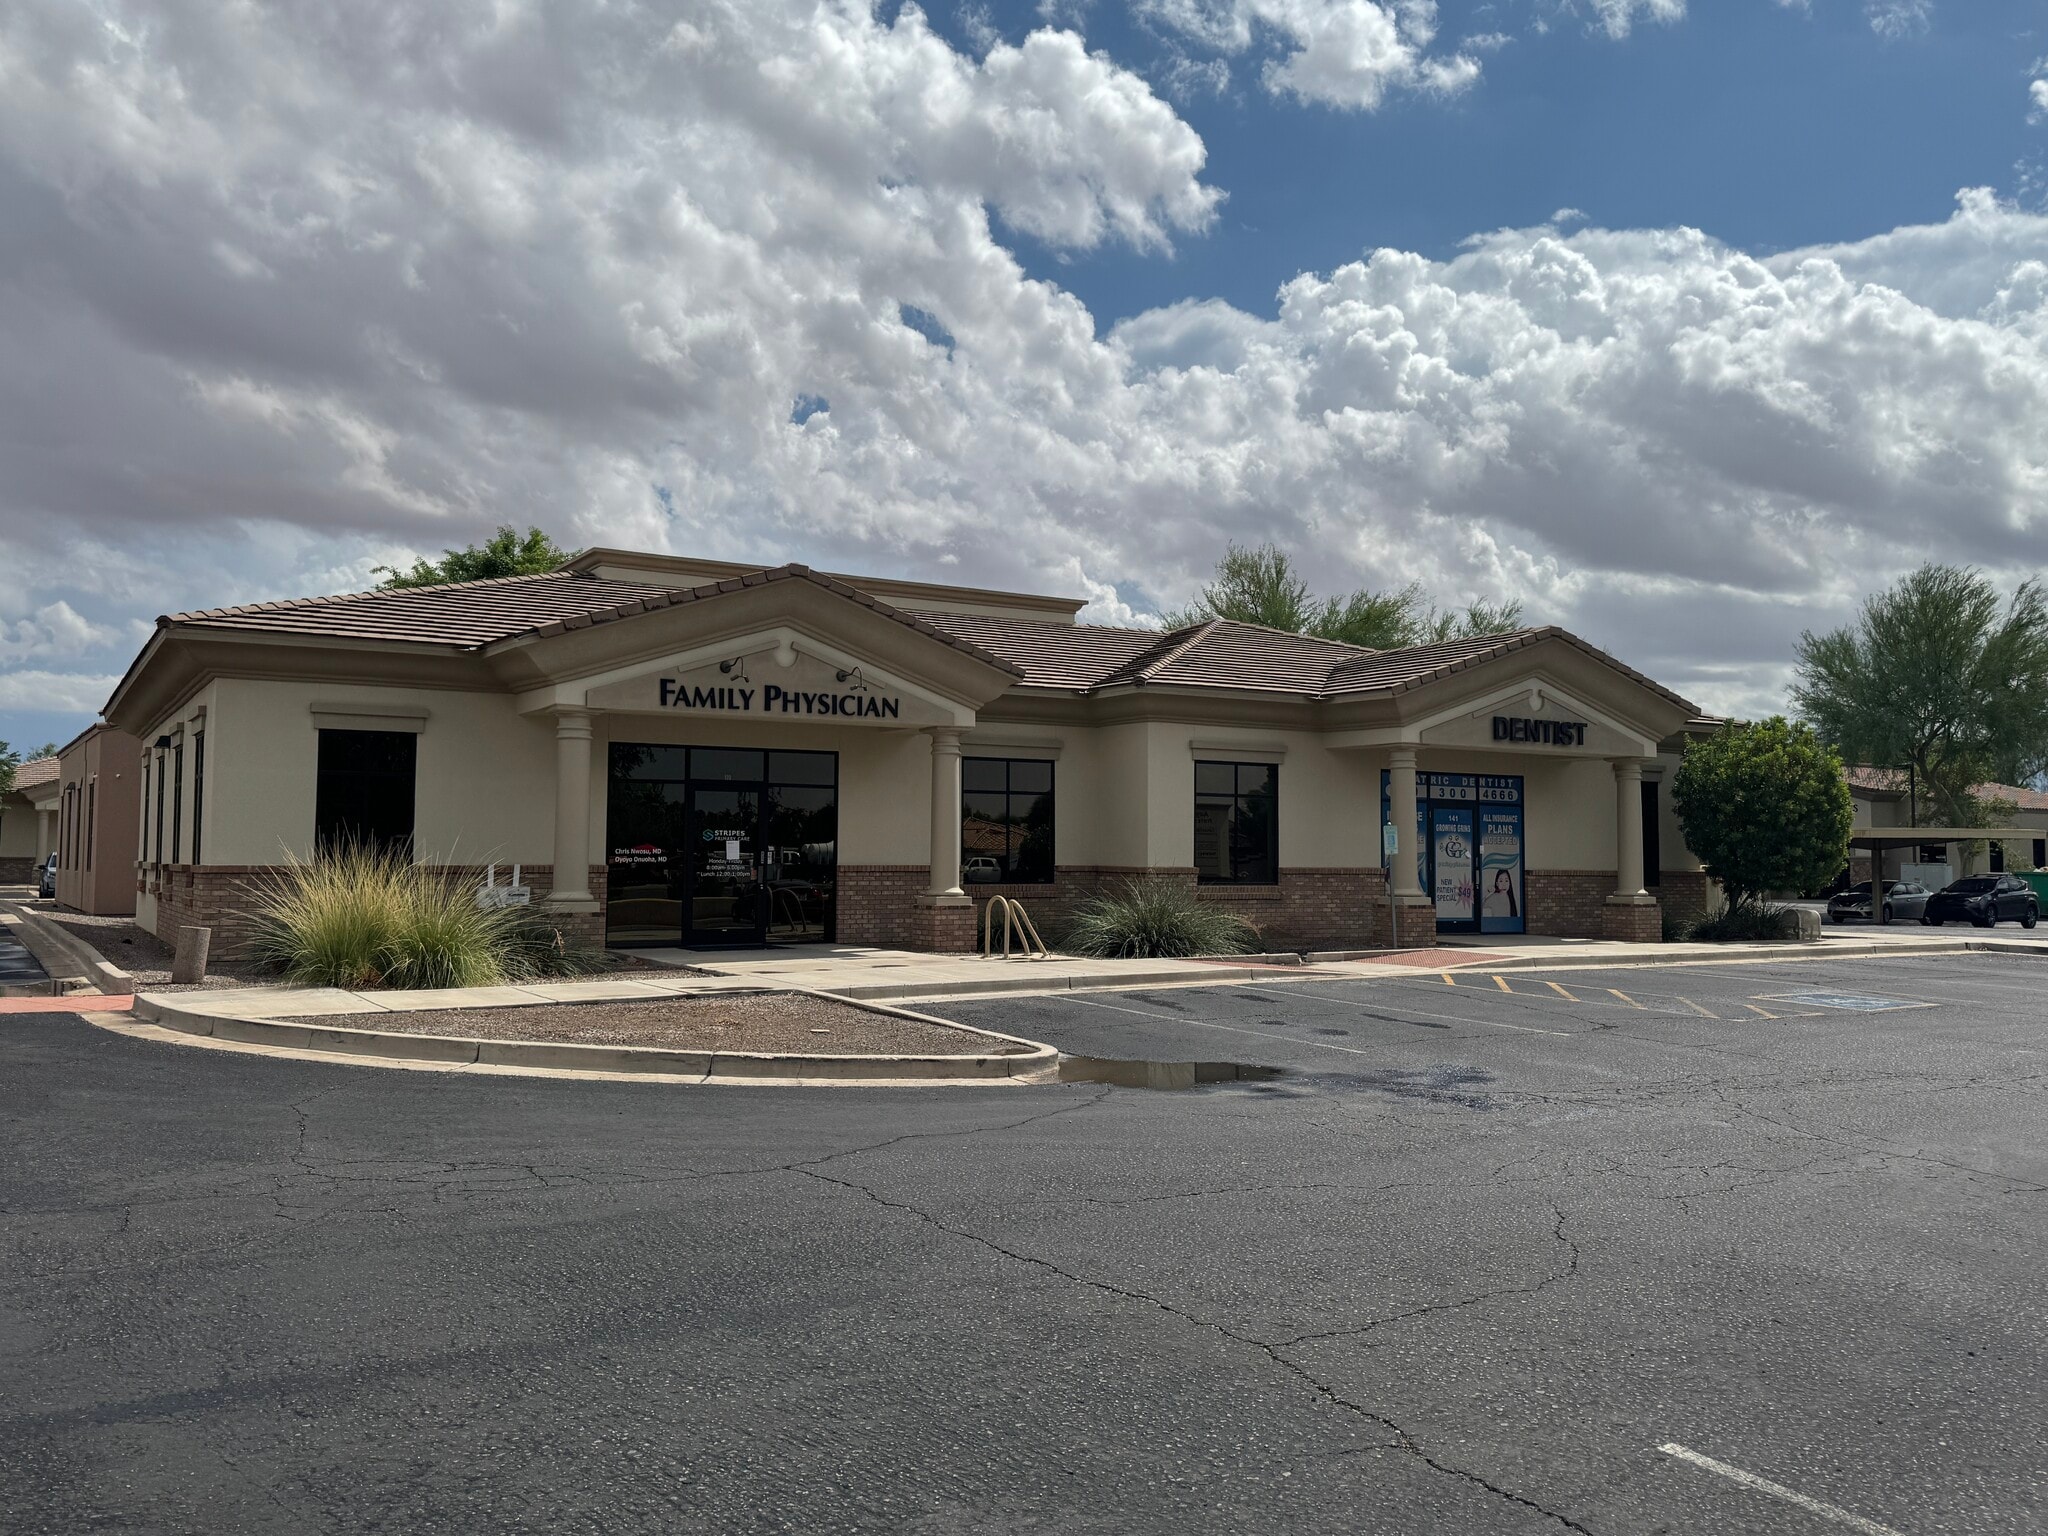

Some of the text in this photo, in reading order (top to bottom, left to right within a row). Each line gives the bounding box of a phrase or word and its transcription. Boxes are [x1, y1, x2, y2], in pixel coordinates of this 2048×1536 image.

[660, 678, 899, 718] FAMILY PHYSICIAN
[1493, 716, 1588, 746] DENTIST
[1439, 788, 1514, 800] 300 4666
[1483, 814, 1518, 823] ALL INSURANCE
[714, 829, 746, 837] STRIPES
[1487, 824, 1513, 835] PLANS
[1483, 835, 1518, 846] ACCEPTED
[1440, 878, 1453, 886] NEW
[1436, 886, 1471, 898] PATIENT $49
[1436, 894, 1457, 902] SPECIAL
